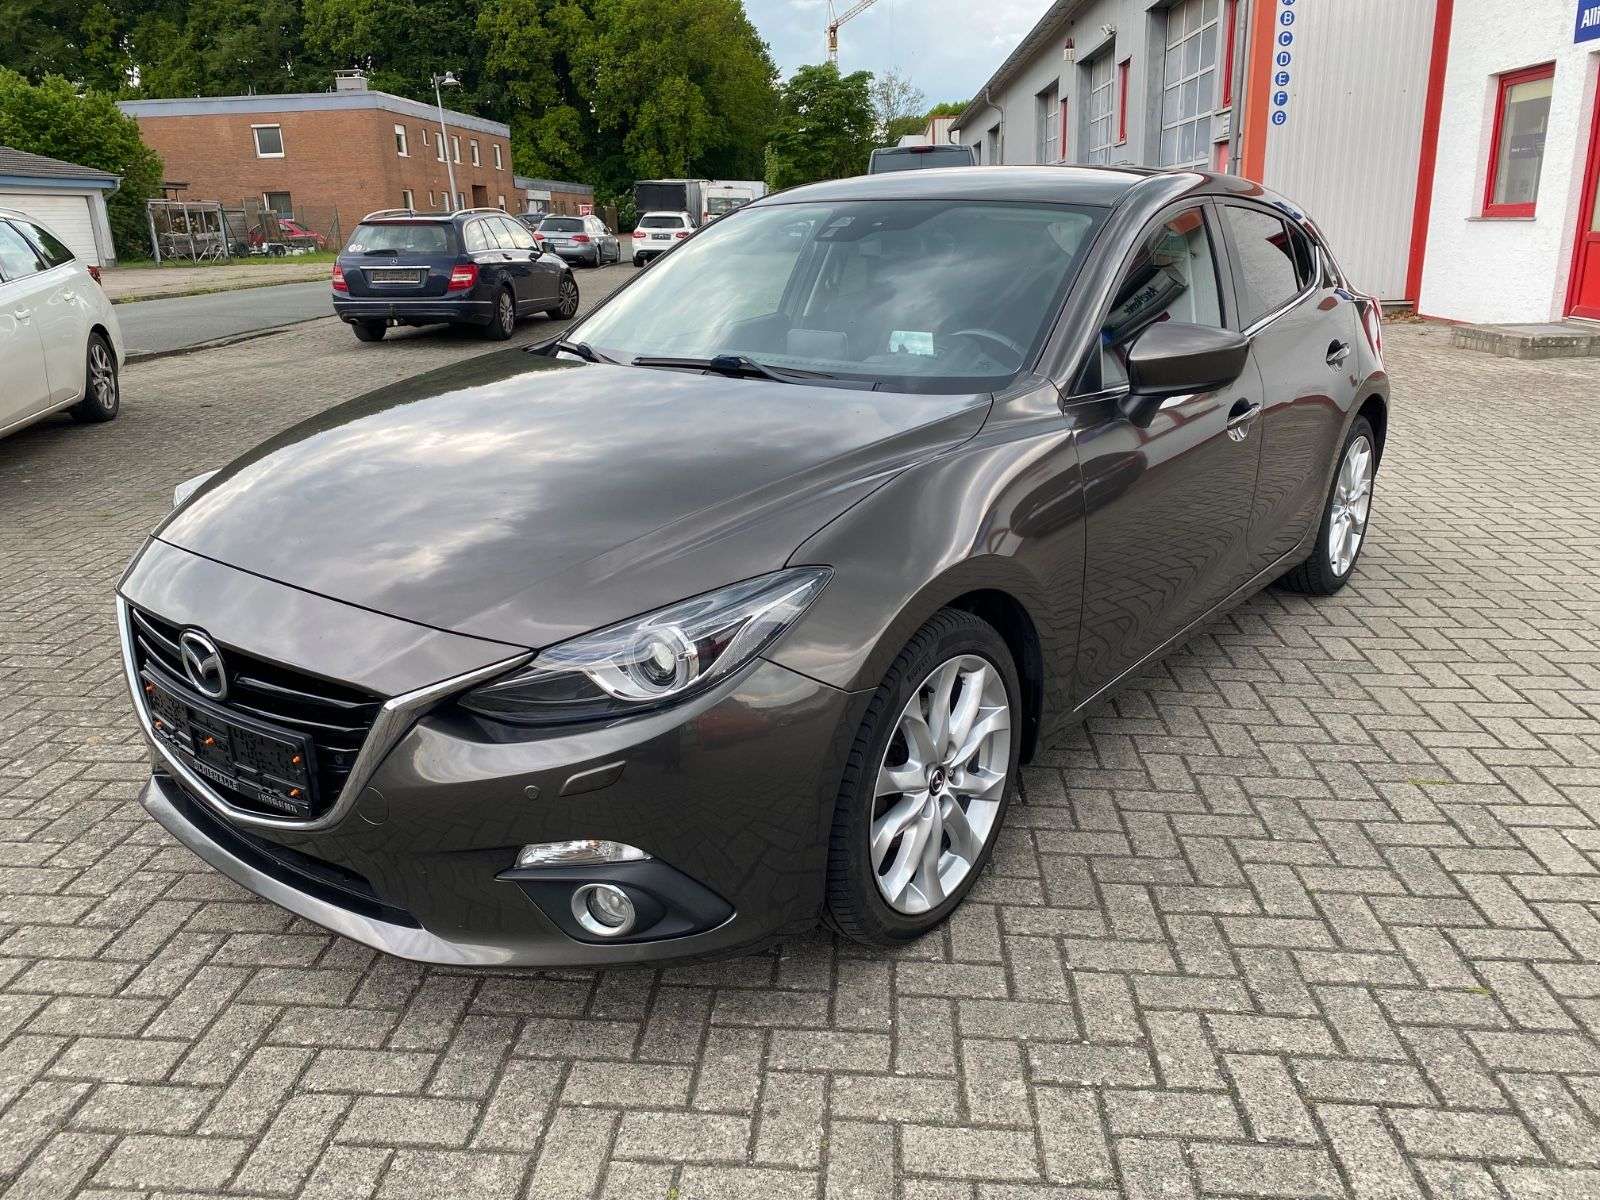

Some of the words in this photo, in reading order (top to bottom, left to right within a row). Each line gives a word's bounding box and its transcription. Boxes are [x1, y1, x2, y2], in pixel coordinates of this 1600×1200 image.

[1282, 12, 1292, 24] B
[1281, 32, 1291, 45] C
[1279, 52, 1289, 65] D
[1278, 72, 1288, 85] E
[1276, 92, 1286, 105] F
[1274, 112, 1284, 124] G
